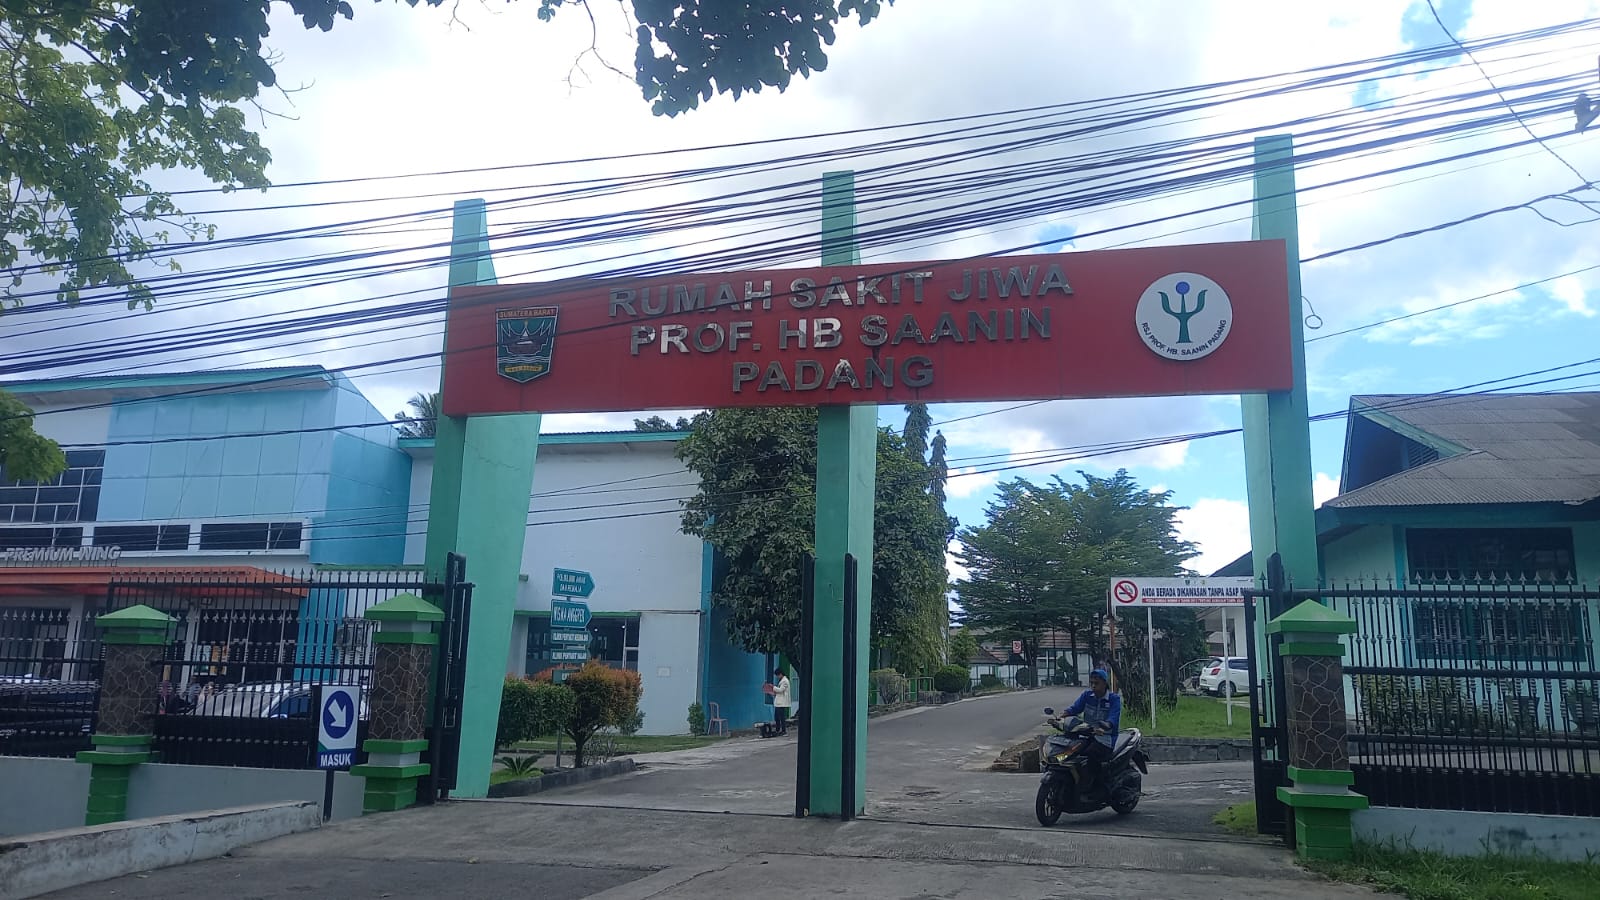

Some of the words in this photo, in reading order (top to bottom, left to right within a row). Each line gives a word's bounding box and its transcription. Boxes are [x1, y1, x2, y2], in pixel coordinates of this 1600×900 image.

[609, 280, 772, 317] RUMAH
[789, 271, 933, 307] SAKIT
[948, 264, 1074, 301] JIWA
[499, 309, 532, 318] SUMATERA
[533, 308, 555, 317] BARAT
[630, 321, 762, 355] PROF.
[779, 317, 842, 349] HB
[859, 307, 1052, 347] SAANIN
[1142, 322, 1151, 336] RSJ
[1181, 343, 1209, 355] SAANIN
[1207, 319, 1227, 346] PADANG
[732, 355, 935, 393] PADANG
[4, 547, 74, 561] PREMIUM
[79, 545, 120, 560] WING
[1141, 587, 1155, 597] ANDA
[1156, 587, 1176, 597] BERADA
[1208, 587, 1224, 597] TANPA
[1225, 587, 1239, 597] ASAP
[320, 753, 351, 767] MASUK
